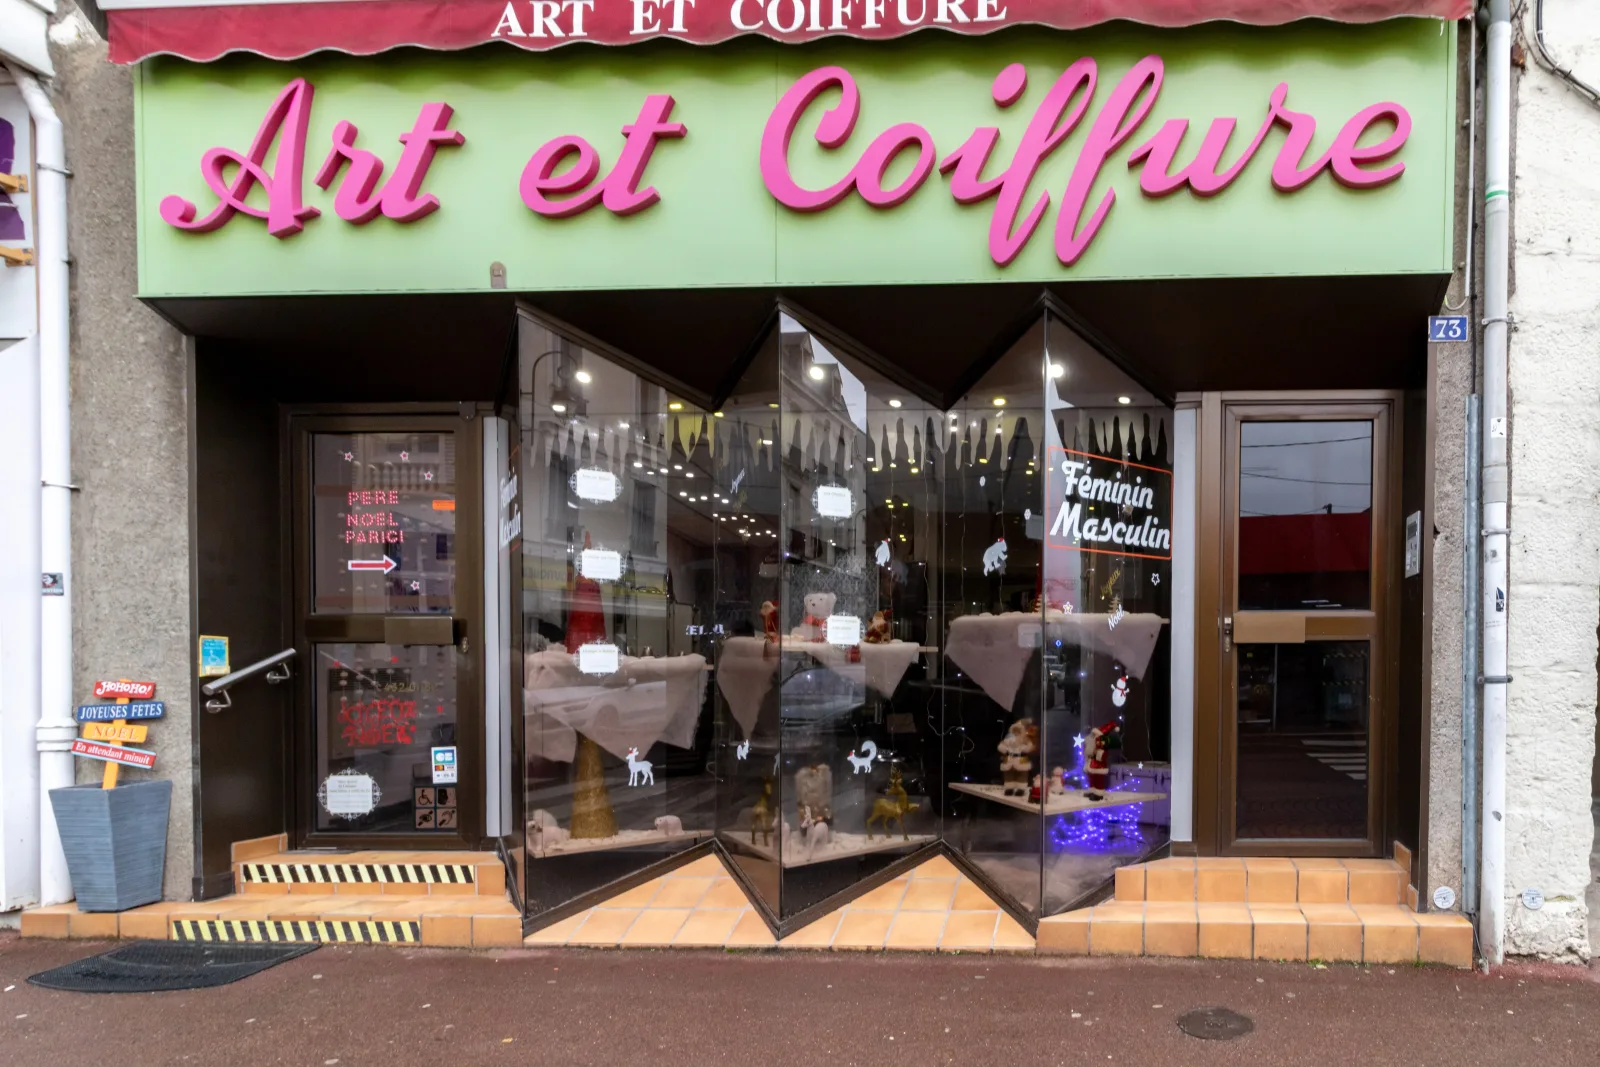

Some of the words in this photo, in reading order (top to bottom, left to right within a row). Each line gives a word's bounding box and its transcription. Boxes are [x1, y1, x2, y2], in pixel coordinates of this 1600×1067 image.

[491, 0, 595, 38] ART
[629, 0, 697, 36] ET
[730, 0, 1008, 34] COIFFURE
[160, 77, 466, 239] Art
[519, 94, 688, 219] et
[759, 54, 1412, 269] Coiffure
[1435, 319, 1461, 338] 73
[347, 490, 400, 506] PERE
[1061, 460, 1154, 510] Féminin
[1049, 500, 1171, 550] Masculin
[80, 705, 128, 720] JOYEUSES
[131, 703, 163, 718] FETES
[75, 741, 87, 752] En
[87, 744, 123, 759] attendant
[124, 752, 150, 765] minuit
